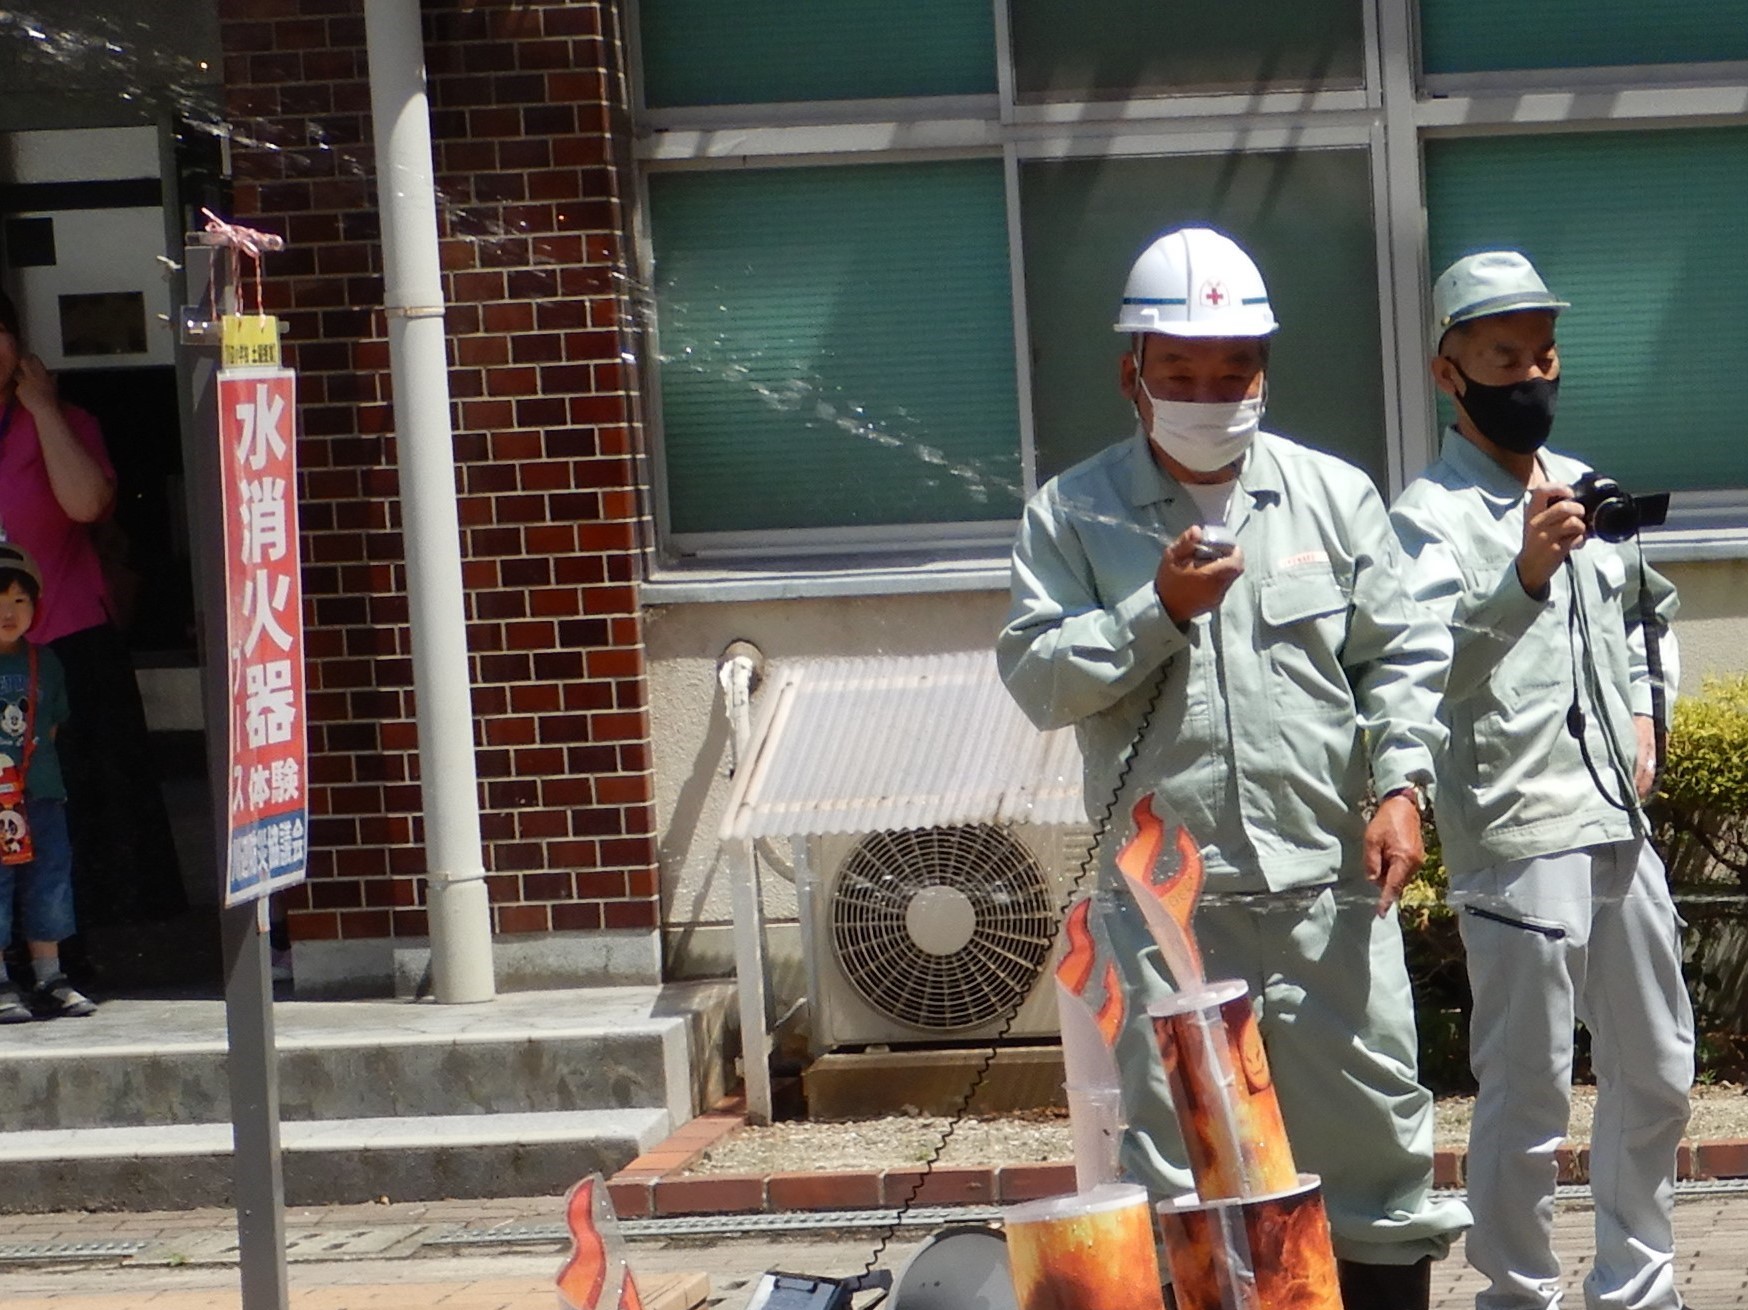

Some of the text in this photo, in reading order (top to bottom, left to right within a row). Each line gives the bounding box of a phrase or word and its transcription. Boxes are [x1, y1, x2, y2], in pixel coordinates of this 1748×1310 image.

[236, 384, 297, 750] 水消火器
[248, 757, 299, 811] 体験
